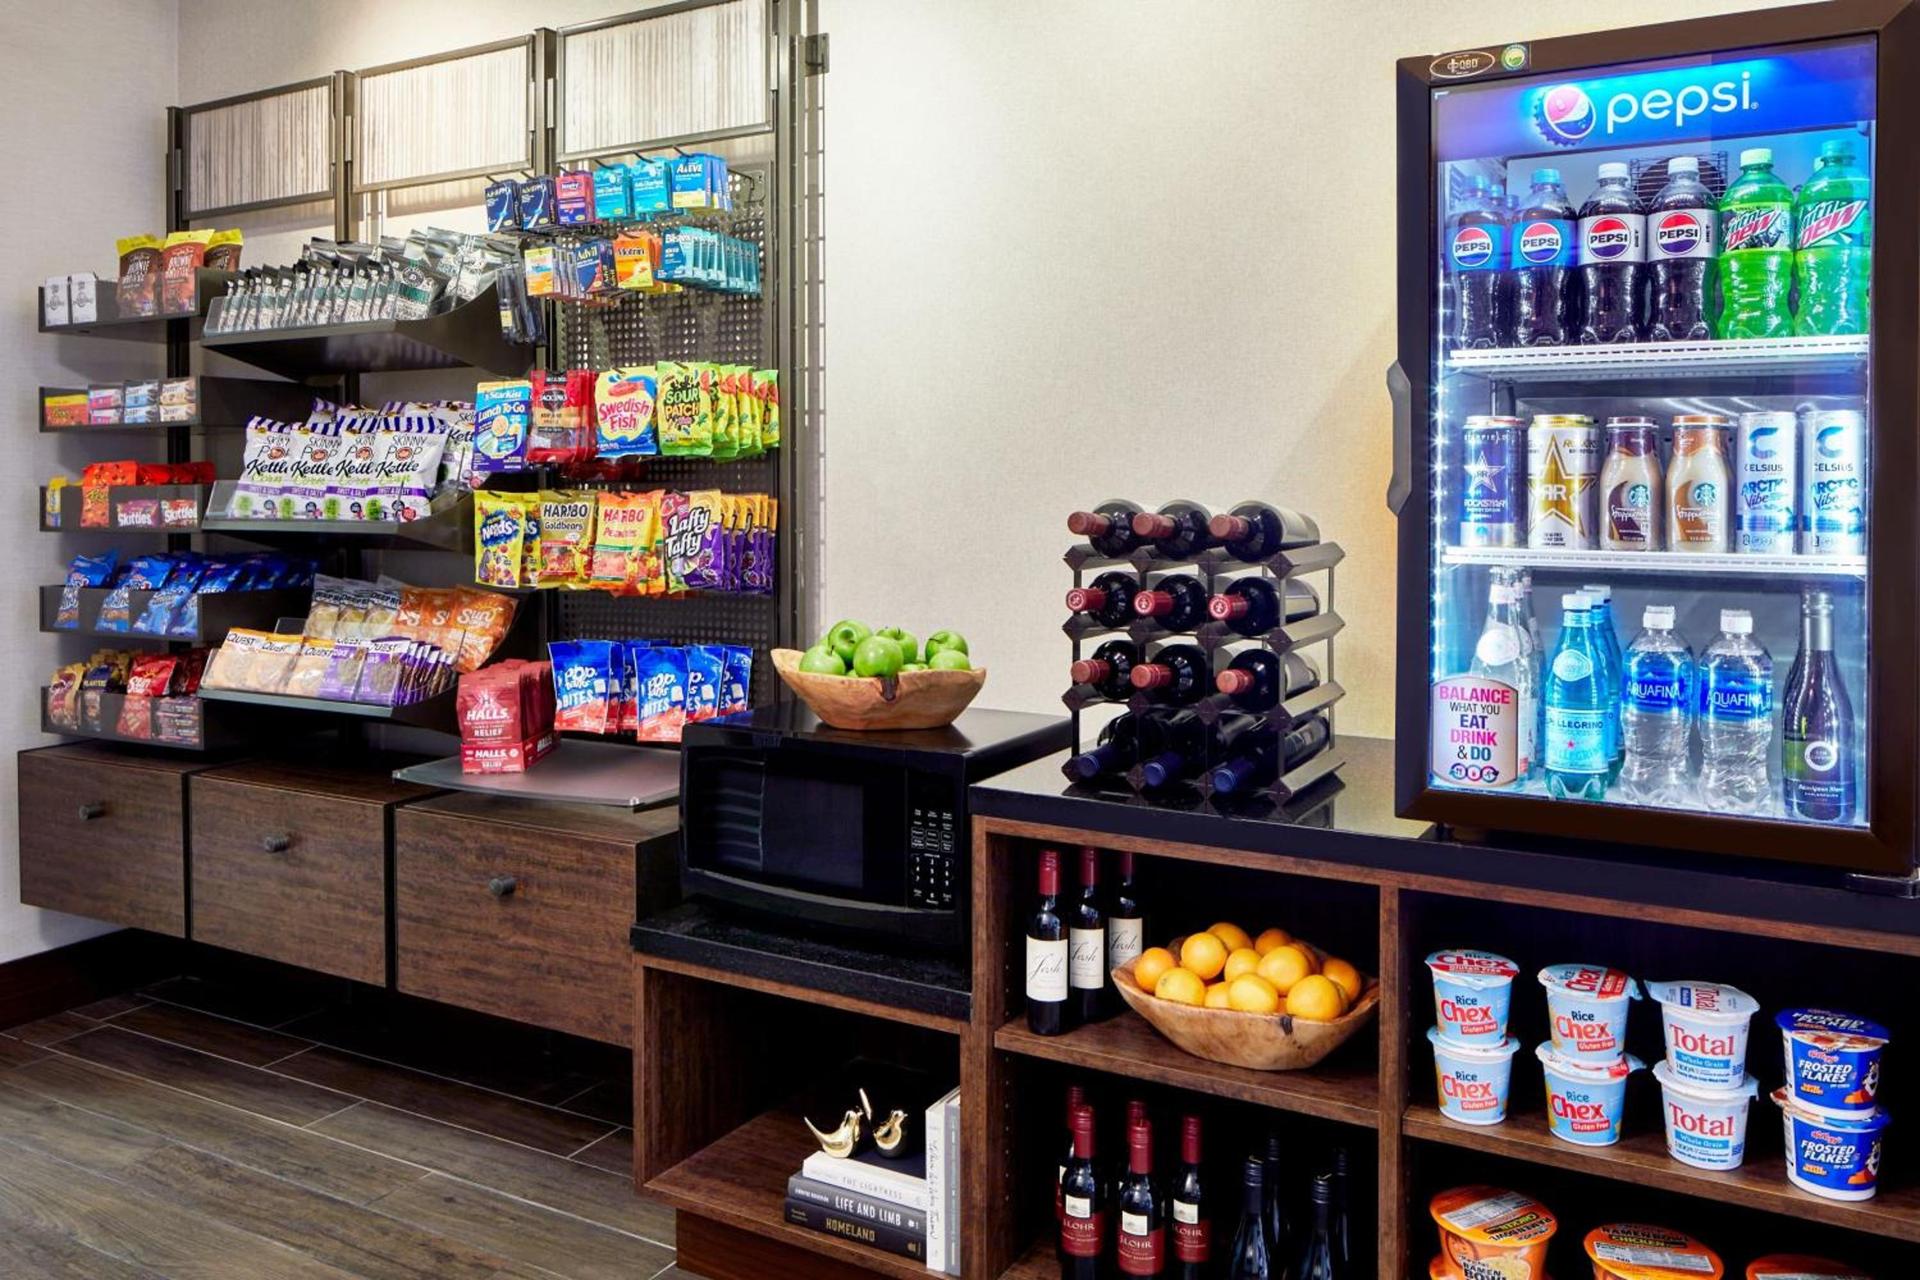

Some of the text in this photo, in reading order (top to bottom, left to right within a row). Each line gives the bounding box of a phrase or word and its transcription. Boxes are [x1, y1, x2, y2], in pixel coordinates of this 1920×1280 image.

[1607, 71, 1751, 134] pepsi
[1590, 233, 1628, 244] PEPSI
[1660, 228, 1698, 240] PEPSI
[1455, 242, 1491, 253] PEPSI
[1523, 237, 1559, 248] PEPSI
[666, 387, 698, 404] SOUR
[479, 404, 502, 422] Lunch
[599, 400, 650, 421] Swedish
[665, 402, 698, 417] PATCH
[609, 415, 638, 431] Fish
[290, 460, 334, 479] Kettle
[376, 460, 420, 478] Kettle
[1744, 463, 1783, 472] CELSIUS
[117, 511, 152, 525] Skittles
[164, 504, 197, 523] Skittles
[543, 504, 588, 518] HARIBO
[545, 521, 583, 531] Goldbears
[669, 507, 711, 535] Laffy
[482, 520, 513, 541] Nerds
[665, 533, 703, 556] Taffy
[457, 608, 489, 625] Sun
[227, 633, 255, 646] QUEST
[1439, 686, 1510, 704] BALANCE
[1626, 682, 1681, 699] AQUAFINA
[1706, 690, 1763, 708] AQUAFINA
[467, 708, 509, 720] HALLS
[1450, 701, 1500, 715] WHAT YOU
[474, 728, 502, 737] RELIEF
[1451, 730, 1498, 746] DRINK
[475, 749, 507, 758] HALLS
[1457, 745, 1491, 761] & DO
[1436, 954, 1510, 968] Chex
[1455, 995, 1477, 1005] Rice
[1695, 987, 1719, 1011] Total
[1441, 999, 1492, 1022] Chex
[1571, 1010, 1594, 1021] Rice
[1462, 1025, 1484, 1033] Gluten
[1555, 1015, 1609, 1039] Chex
[1579, 1042, 1601, 1050] Gluten
[1669, 1023, 1734, 1056] Total
[1798, 1060, 1852, 1074] FROSTED
[1455, 1070, 1477, 1081] Rice
[1802, 1070, 1847, 1083] FLAKES
[1442, 1074, 1492, 1098] Chex
[1566, 1090, 1590, 1102] Rice
[1462, 1101, 1484, 1109] Gluten
[1551, 1094, 1604, 1119] Chex
[1668, 1101, 1734, 1136] Total
[1572, 1122, 1595, 1130] Gluten
[1680, 1133, 1702, 1144] Whole
[1801, 1140, 1856, 1154] FROSTED
[1804, 1150, 1849, 1164] FLAKES
[835, 1196, 901, 1226] LIFE AND LIMB
[826, 1217, 875, 1242] HOMELAND
[1462, 1262, 1501, 1276] RAMEN
